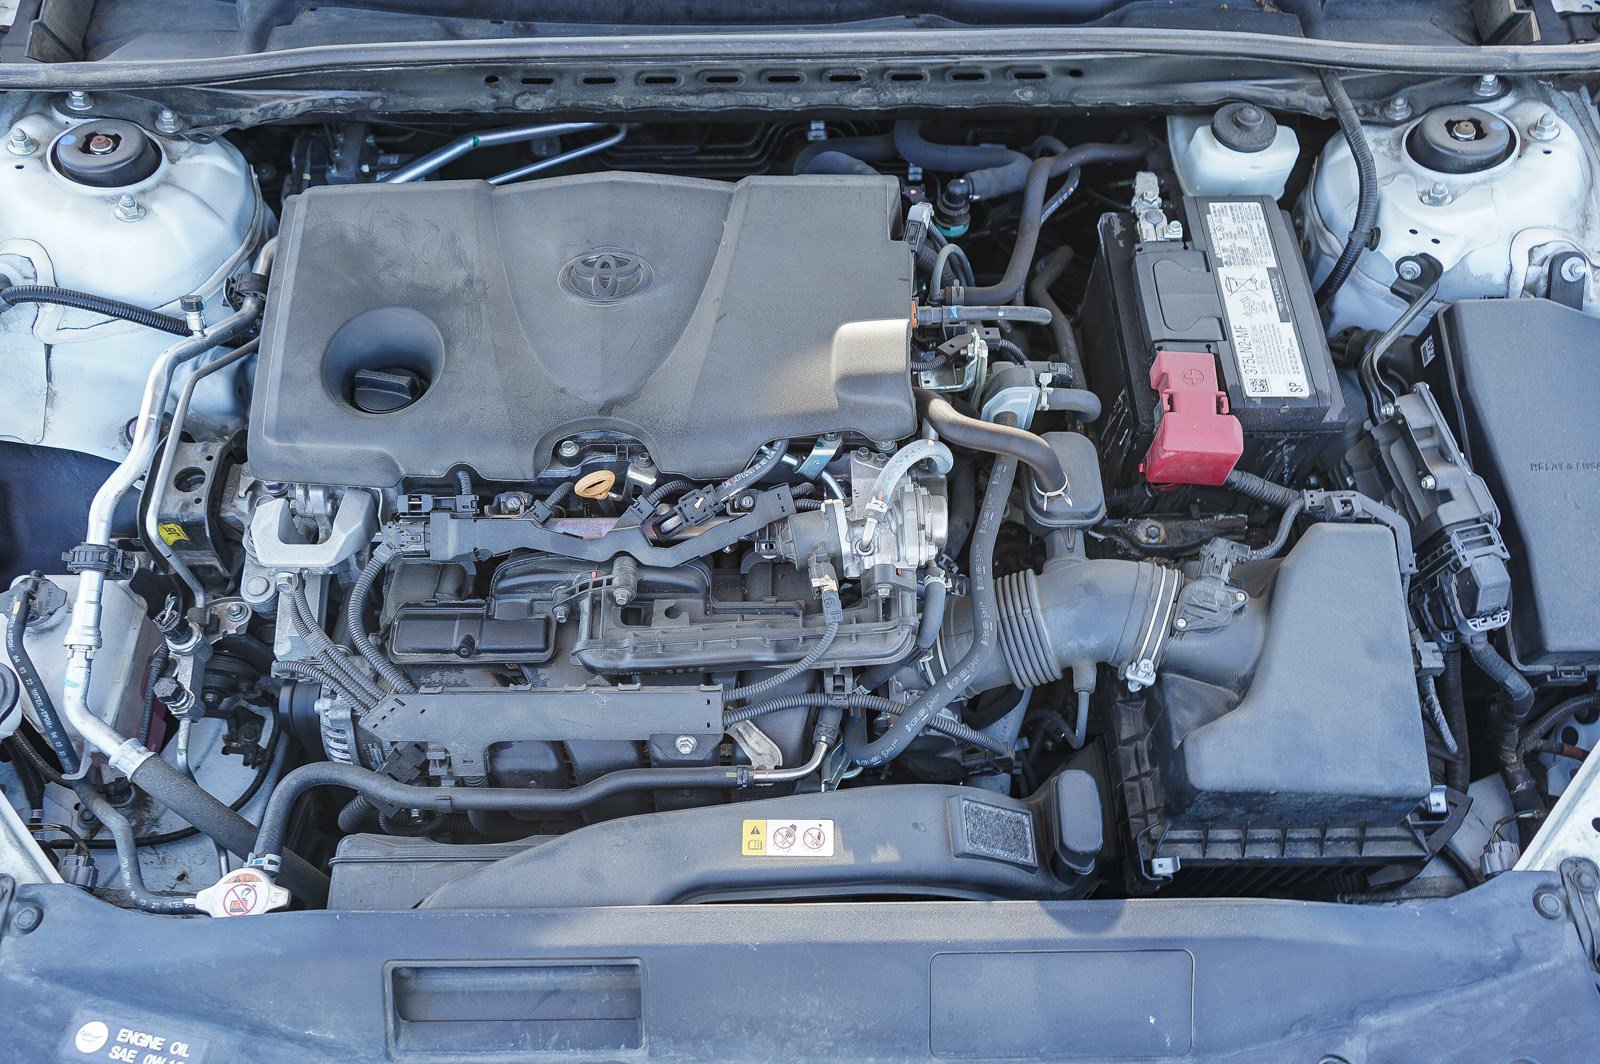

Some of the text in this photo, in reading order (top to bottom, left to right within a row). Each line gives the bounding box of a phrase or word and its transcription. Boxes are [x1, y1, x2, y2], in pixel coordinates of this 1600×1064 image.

[1234, 324, 1258, 375] 375LN2-MF
[1288, 381, 1303, 393] SP
[1530, 462, 1563, 471] RELAY
[116, 1028, 190, 1057] ENGINE OIL
[108, 1045, 138, 1063] SAE
